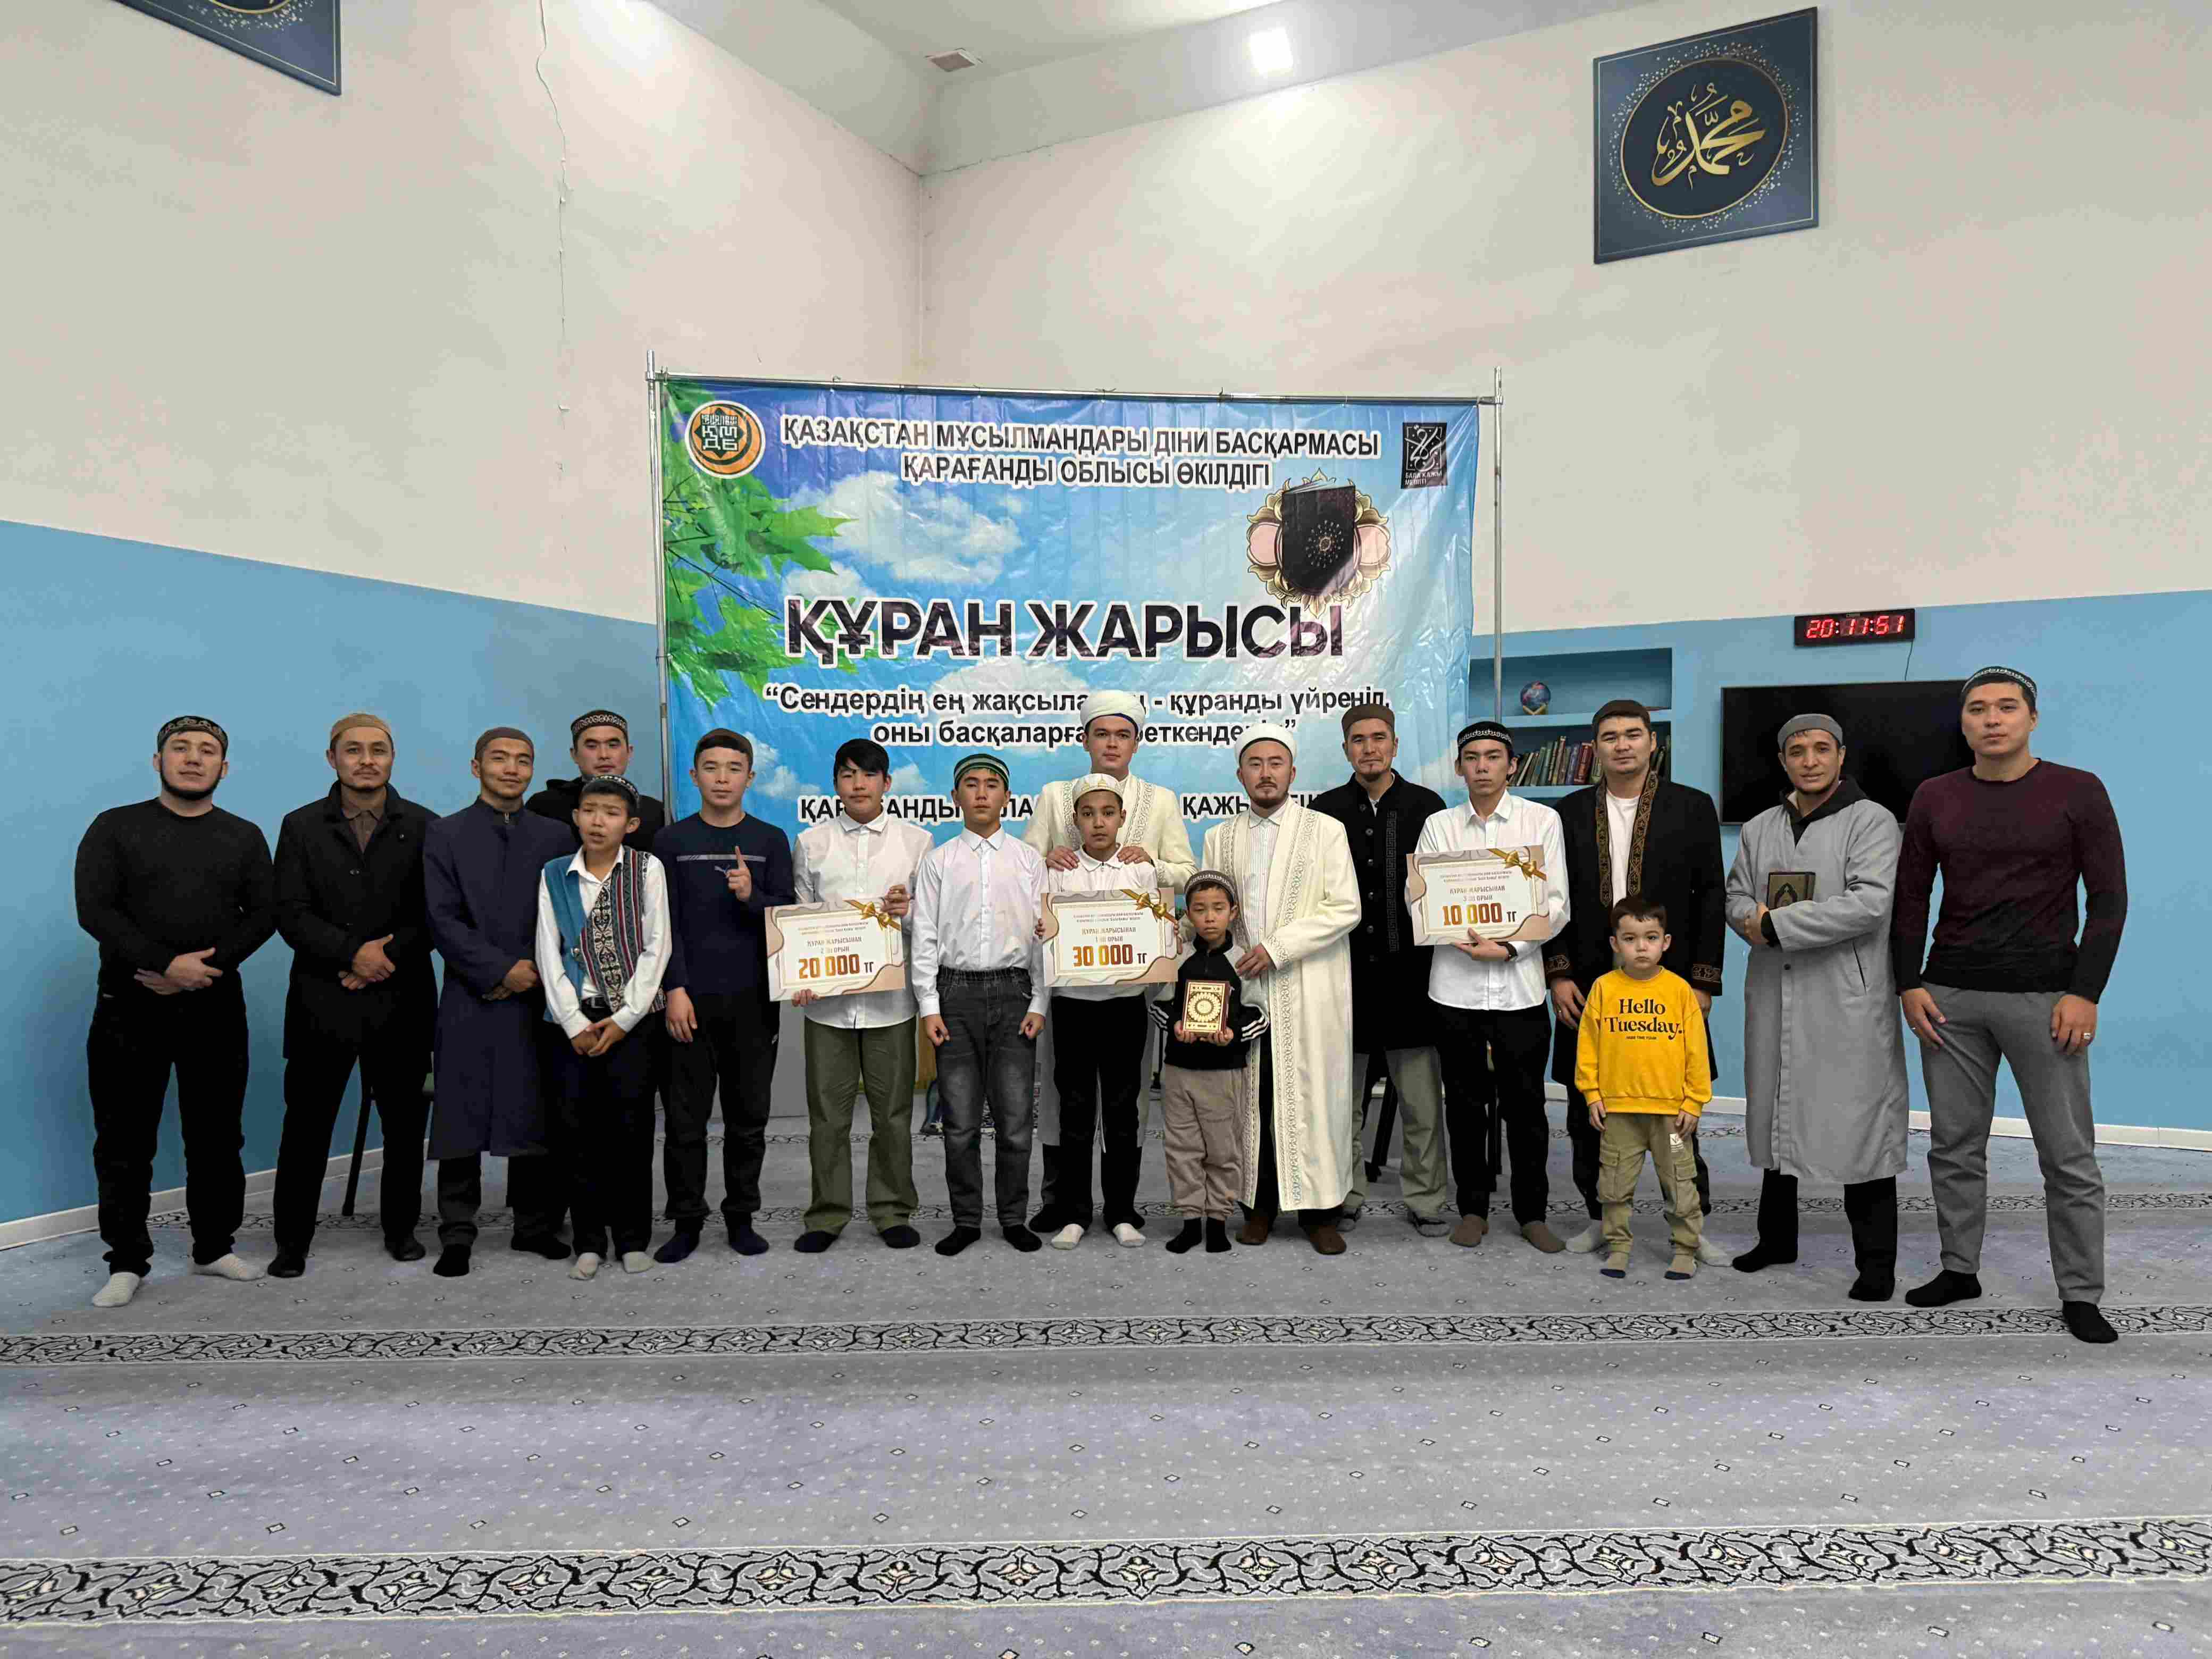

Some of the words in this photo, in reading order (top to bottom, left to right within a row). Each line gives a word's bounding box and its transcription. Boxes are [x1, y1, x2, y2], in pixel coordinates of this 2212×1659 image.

[784, 418, 928, 447] ҚАЗАҚСТАН
[936, 425, 1147, 455] МҰСЫЛМАНДАРЫ
[1154, 431, 1208, 457] ДІНИ
[1216, 432, 1378, 458] БАСҚАРМАСЫ
[904, 456, 1053, 485] ҚАРАҒАНДЫ
[1061, 460, 1169, 484] ОБЛЫСЫ
[1177, 463, 1269, 490] ӨКІЛДІГІ
[788, 599, 1012, 665] ҚҰРАН
[1027, 603, 1343, 658] ЖАРЫСЫ
[1806, 616, 1905, 639] 20:11:51
[933, 694, 965, 714] ең
[973, 694, 1146, 715] жақсыла
[1170, 694, 1281, 716] құранды
[874, 725, 929, 743] оны
[801, 799, 961, 823] ҚАРАНДЫ
[1442, 905, 1462, 926] 10
[1467, 902, 1503, 924] 000
[798, 957, 820, 979] 20
[824, 953, 860, 976] 000
[1073, 945, 1094, 967] 30
[1097, 944, 1133, 965] 000
[1619, 998, 1666, 1015] Hello
